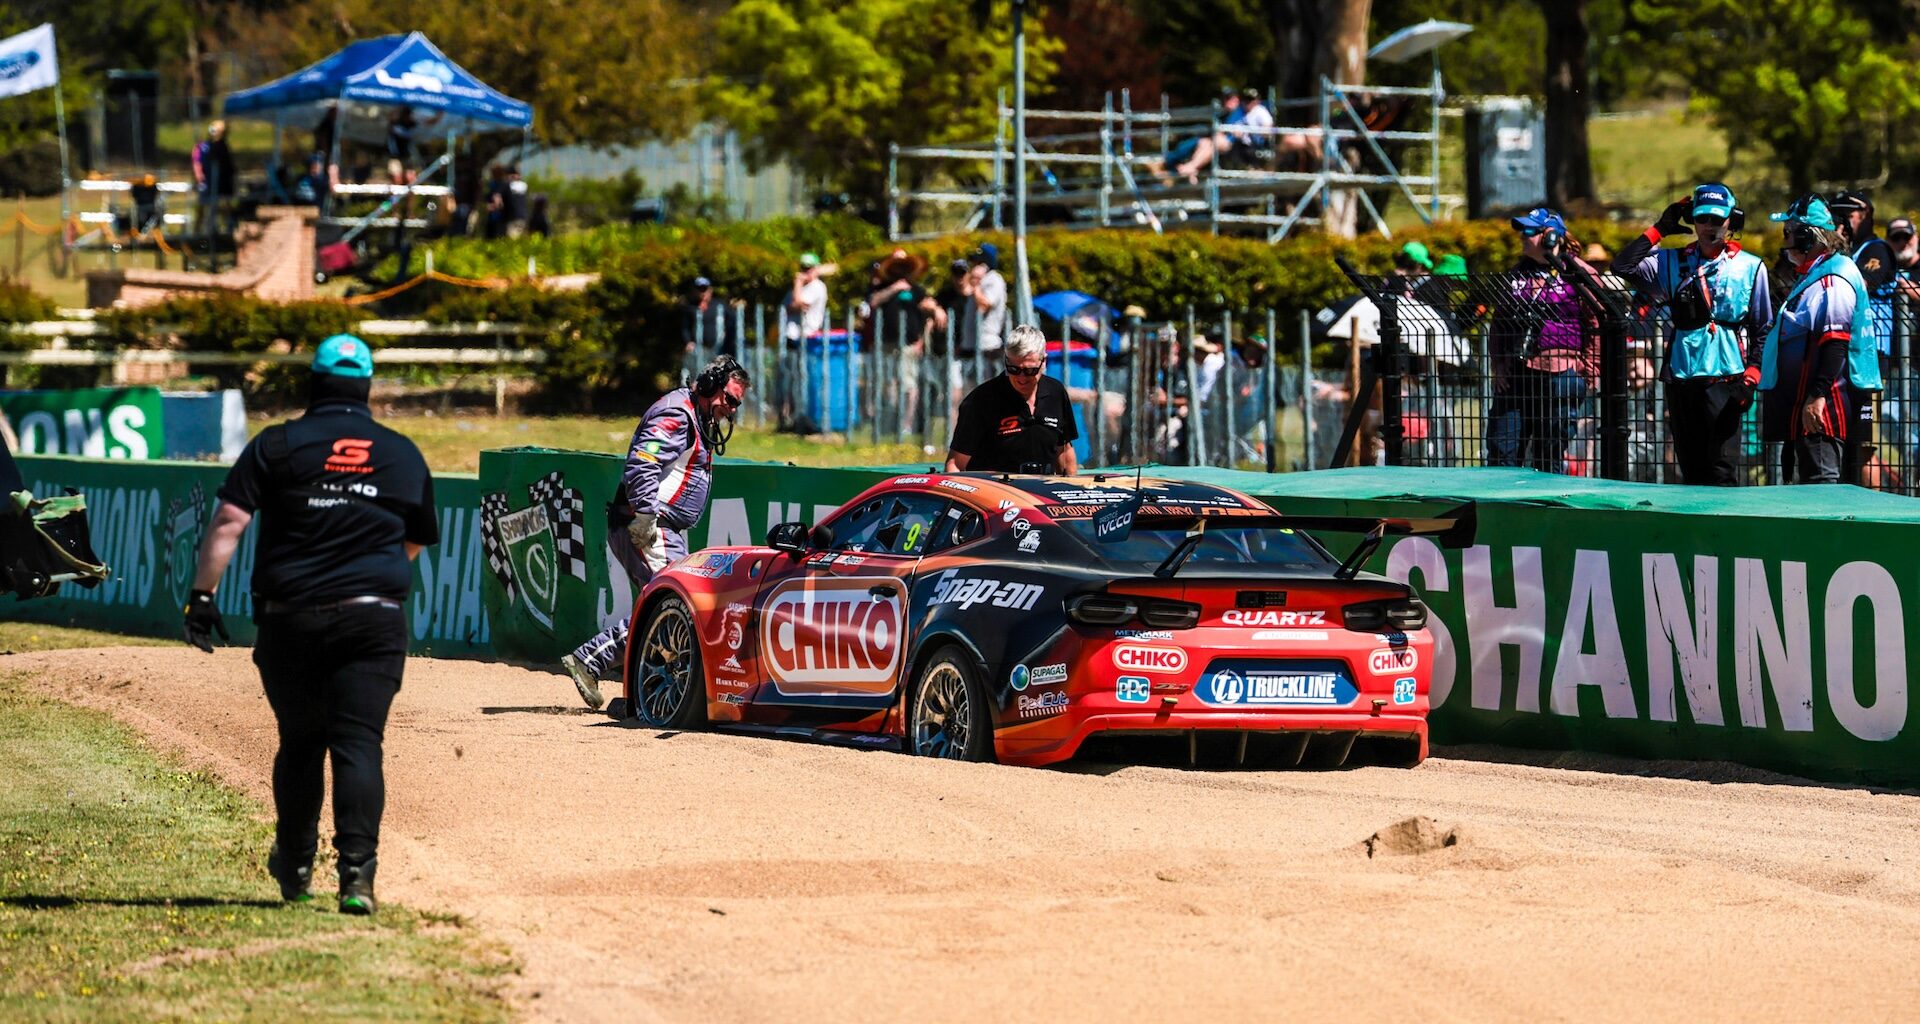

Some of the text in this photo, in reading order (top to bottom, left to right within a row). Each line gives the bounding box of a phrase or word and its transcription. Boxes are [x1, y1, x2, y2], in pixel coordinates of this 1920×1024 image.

[903, 523, 921, 551] 9
[926, 569, 1045, 611] Snap-on
[1221, 610, 1326, 626] QUARTZ
[770, 600, 897, 671] CHIKO
[1119, 650, 1182, 668] CHIKO
[1033, 665, 1065, 678] SUPAGAS
[1119, 679, 1148, 699] PPG
[1246, 676, 1336, 698] TRUCKLINE
